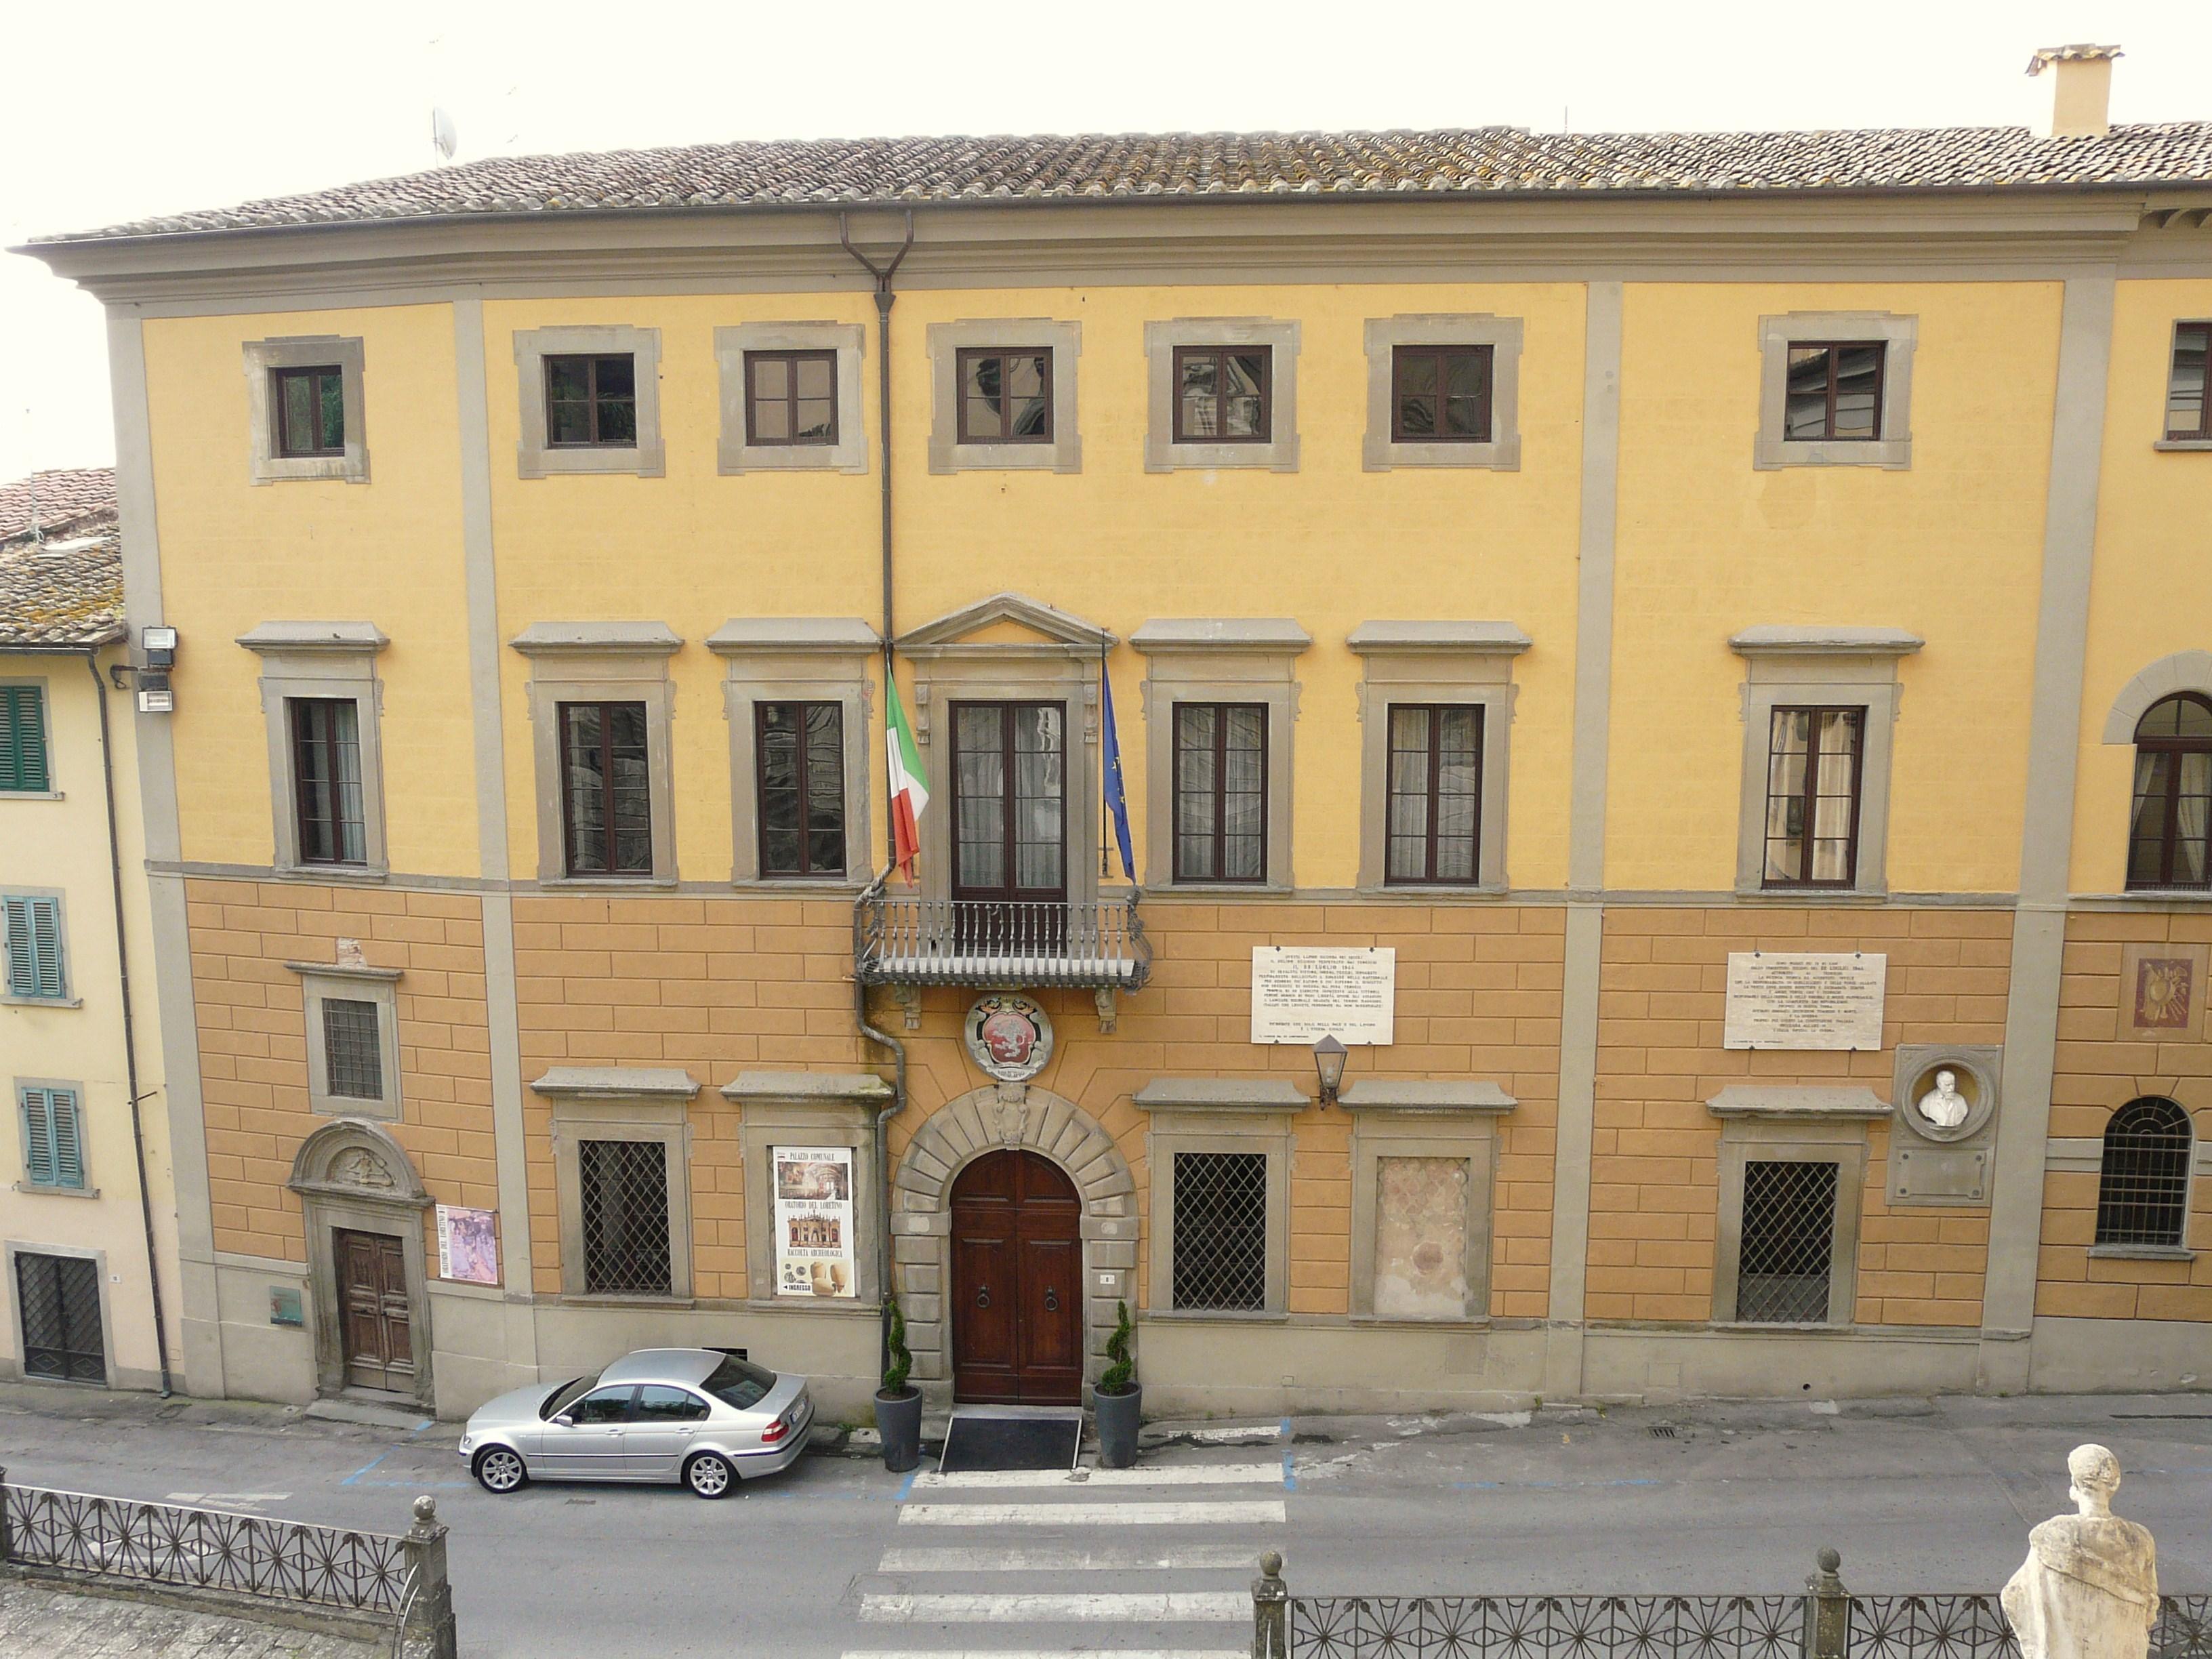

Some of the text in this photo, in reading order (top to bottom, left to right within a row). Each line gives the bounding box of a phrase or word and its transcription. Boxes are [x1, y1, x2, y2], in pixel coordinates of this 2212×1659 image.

[790, 1151, 835, 1161] PALAZZO COMUNALE
[785, 1201, 842, 1210] ORATORIO DEL LORETINO
[438, 1215, 447, 1237] LORETINO
[787, 1248, 843, 1258] RACCOLTA ARCHEOLOGICA
